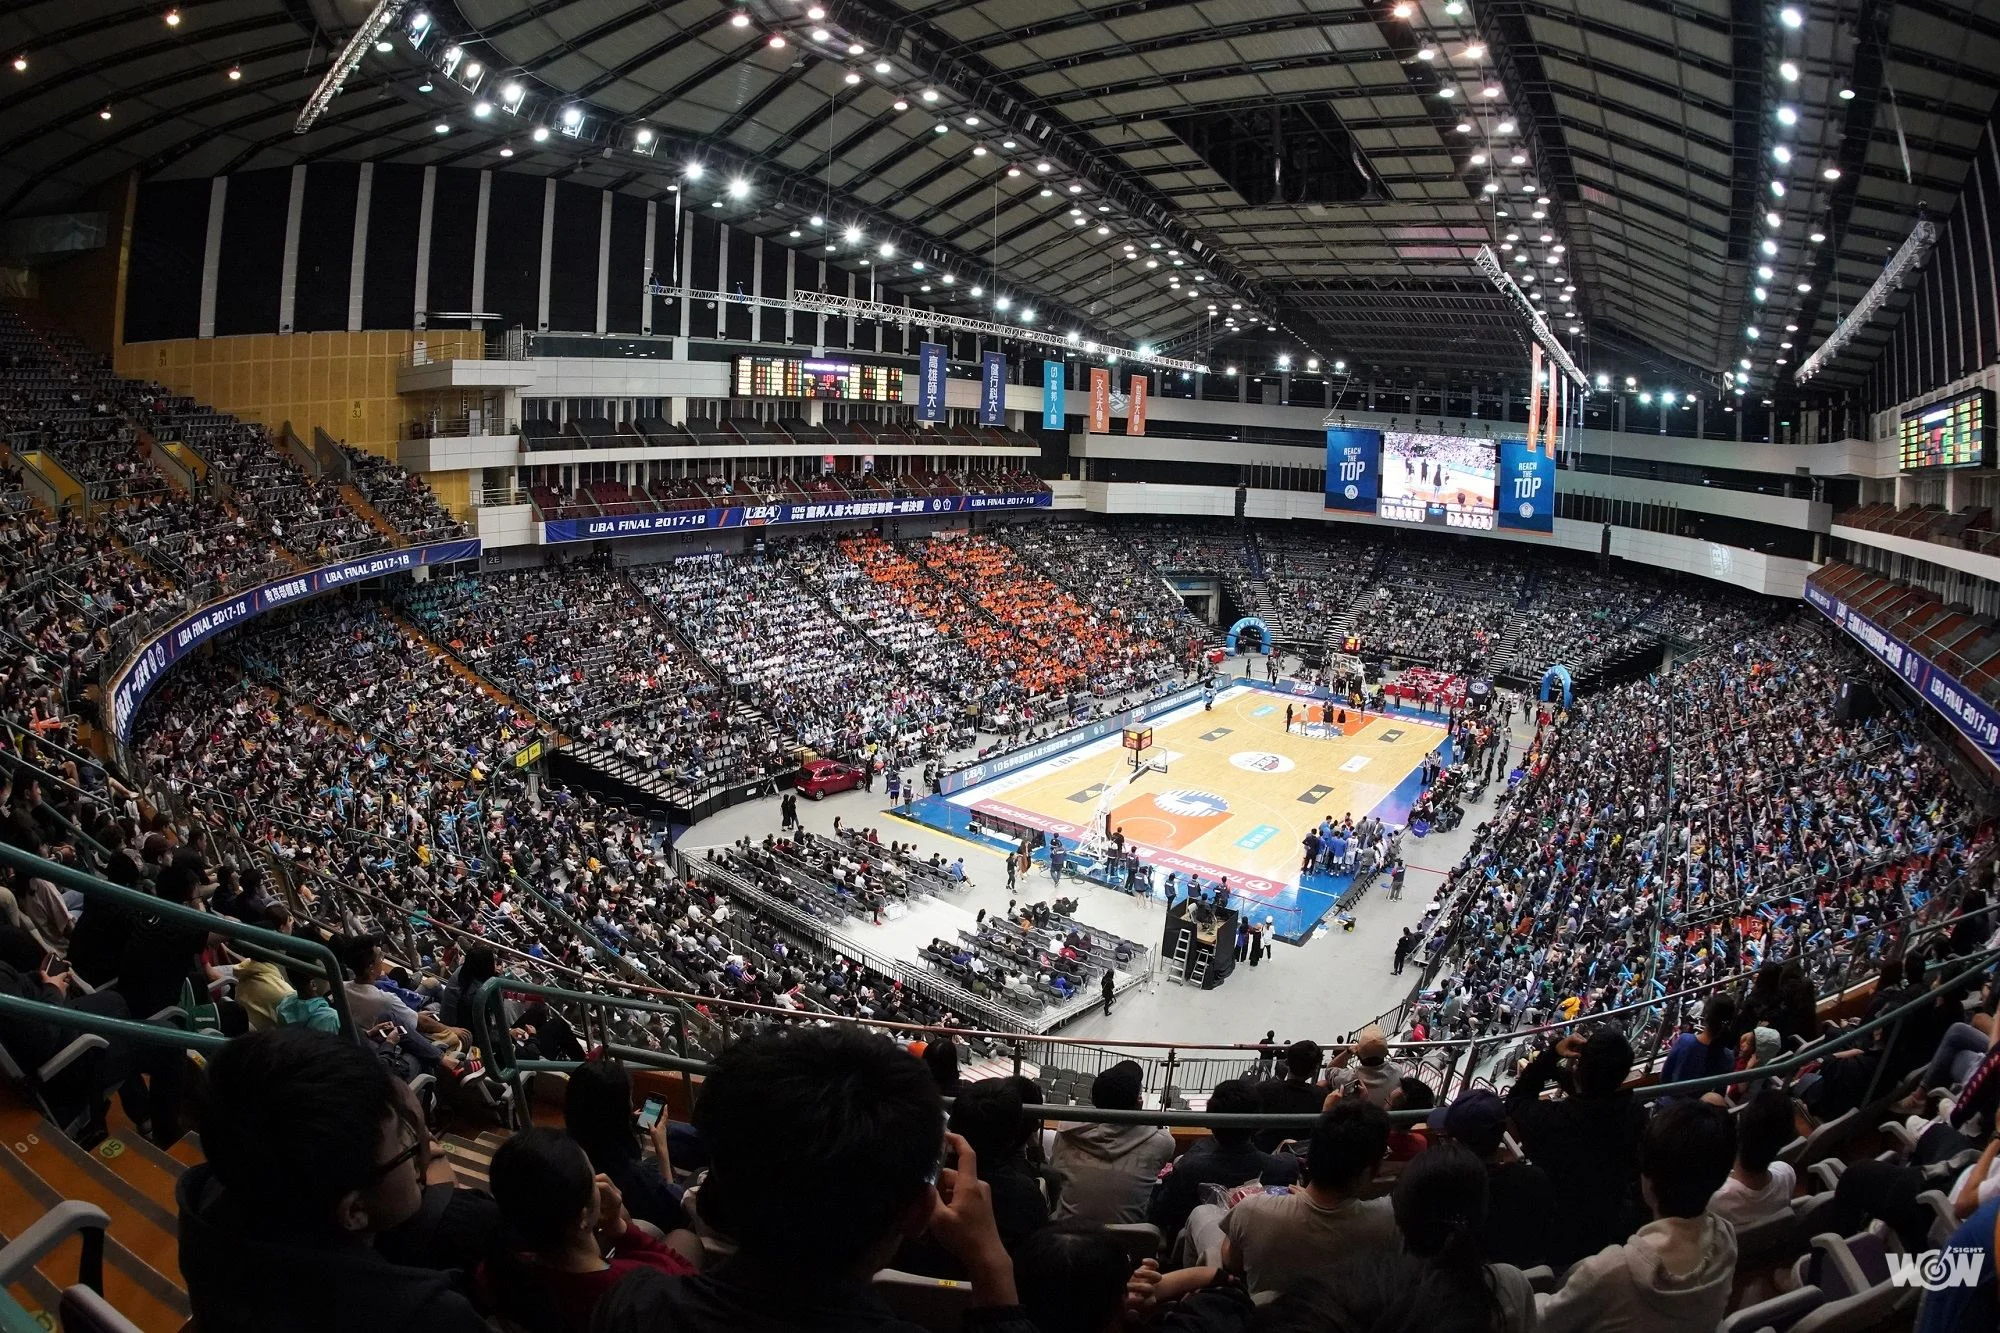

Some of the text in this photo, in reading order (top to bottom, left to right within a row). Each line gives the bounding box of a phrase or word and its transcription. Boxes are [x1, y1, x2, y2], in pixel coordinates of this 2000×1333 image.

[926, 355, 938, 408] 高雄師大
[1343, 447, 1361, 455] REACH
[1340, 461, 1366, 482] TOP
[1519, 462, 1537, 470] REACH
[1523, 470, 1532, 478] THE
[1513, 477, 1542, 499] TOP
[791, 506, 806, 514] 106
[971, 496, 1035, 507] UBA FINAL 2017-18
[745, 505, 776, 519] UBA
[589, 514, 705, 533] UBA FINAL 2017-18
[325, 554, 410, 584] UBA FINAL 2017-18
[178, 601, 246, 648] UBA FINAL 2017-18
[1930, 677, 1999, 746] UBA FINAL 2017-18
[1163, 856, 1246, 884] Transcend
[102, 1141, 121, 1157] 05
